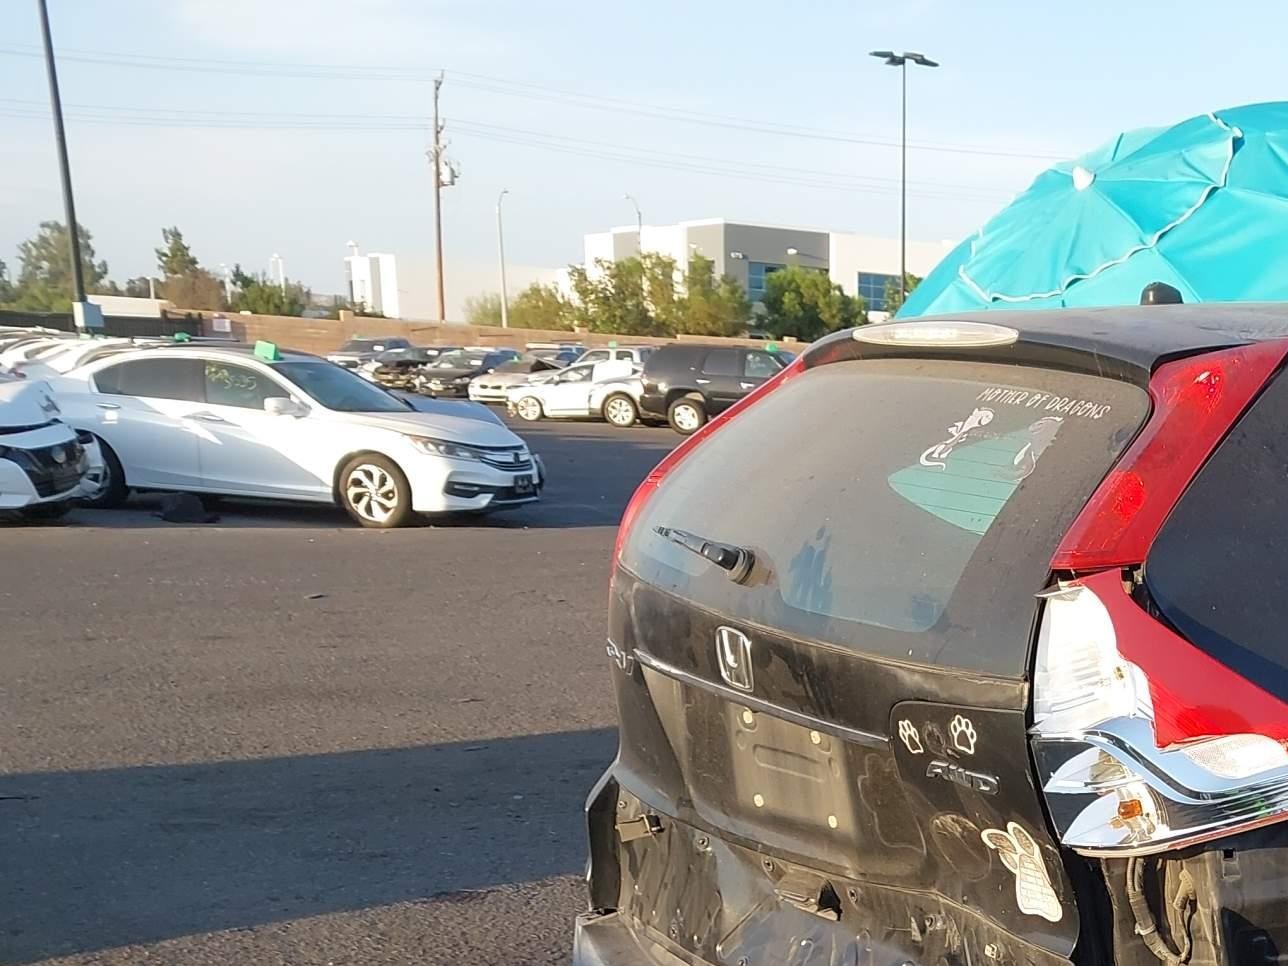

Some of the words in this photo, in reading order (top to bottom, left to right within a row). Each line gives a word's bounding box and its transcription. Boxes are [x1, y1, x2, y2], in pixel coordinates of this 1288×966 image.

[976, 387, 1029, 405] MOTHER
[1025, 393, 1050, 409] OF
[1045, 396, 1112, 420] DRAGONS
[926, 760, 1000, 796] AWD
